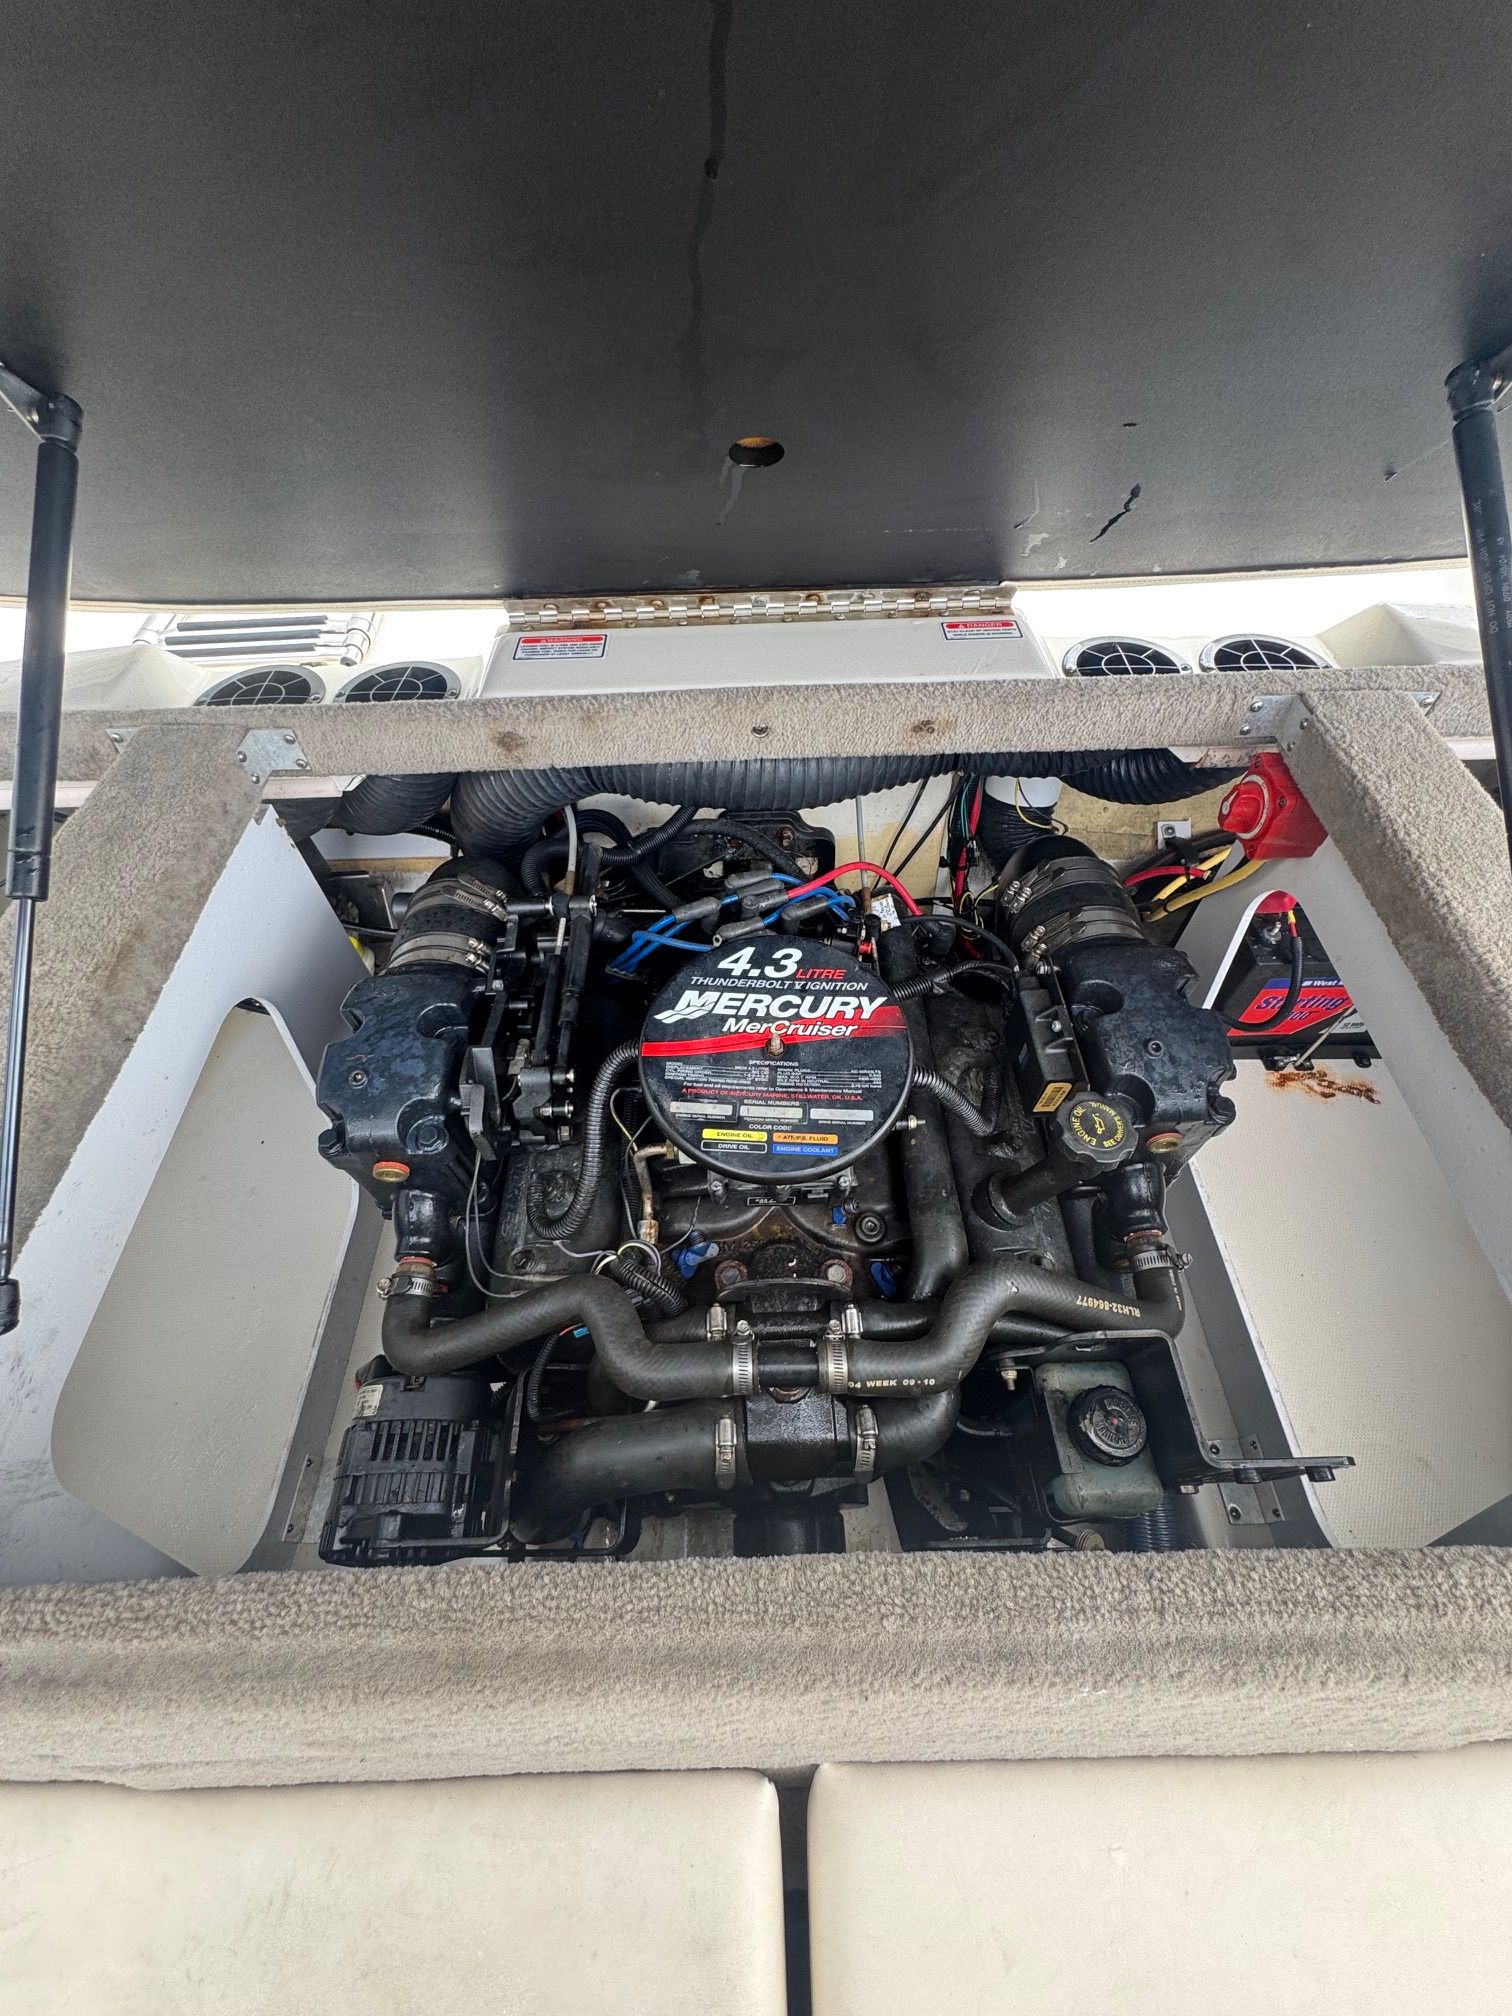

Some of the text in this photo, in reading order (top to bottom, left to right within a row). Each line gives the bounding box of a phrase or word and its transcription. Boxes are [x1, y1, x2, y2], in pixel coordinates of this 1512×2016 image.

[717, 947, 847, 980] 4.3 LITRE
[690, 976, 794, 990] THUNDERBOLT
[805, 982, 868, 991] IGNITION
[673, 990, 888, 1020] MERCURY
[722, 1017, 858, 1037] MerCruiser
[1072, 1106, 1096, 1146] ENGINE OIL
[866, 1379, 898, 1388] WEEK
